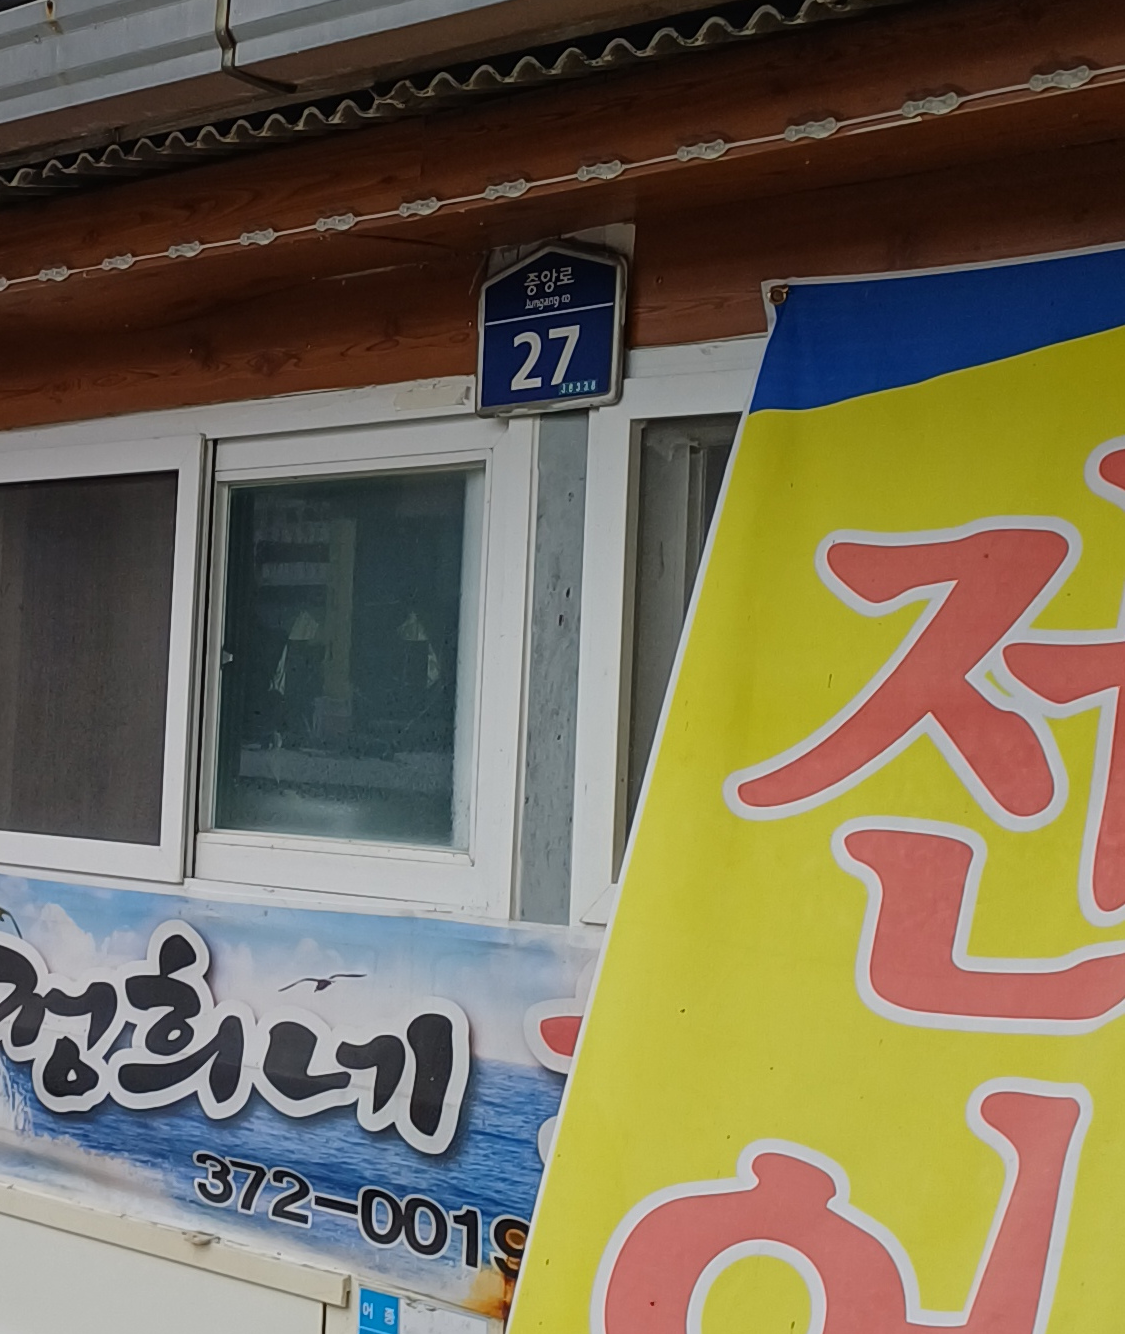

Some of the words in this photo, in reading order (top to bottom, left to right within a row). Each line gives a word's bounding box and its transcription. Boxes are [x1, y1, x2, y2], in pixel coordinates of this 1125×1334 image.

[523, 266, 575, 296] 중앙로
[510, 324, 581, 391] 27
[193, 1150, 529, 1279] 372-0019
